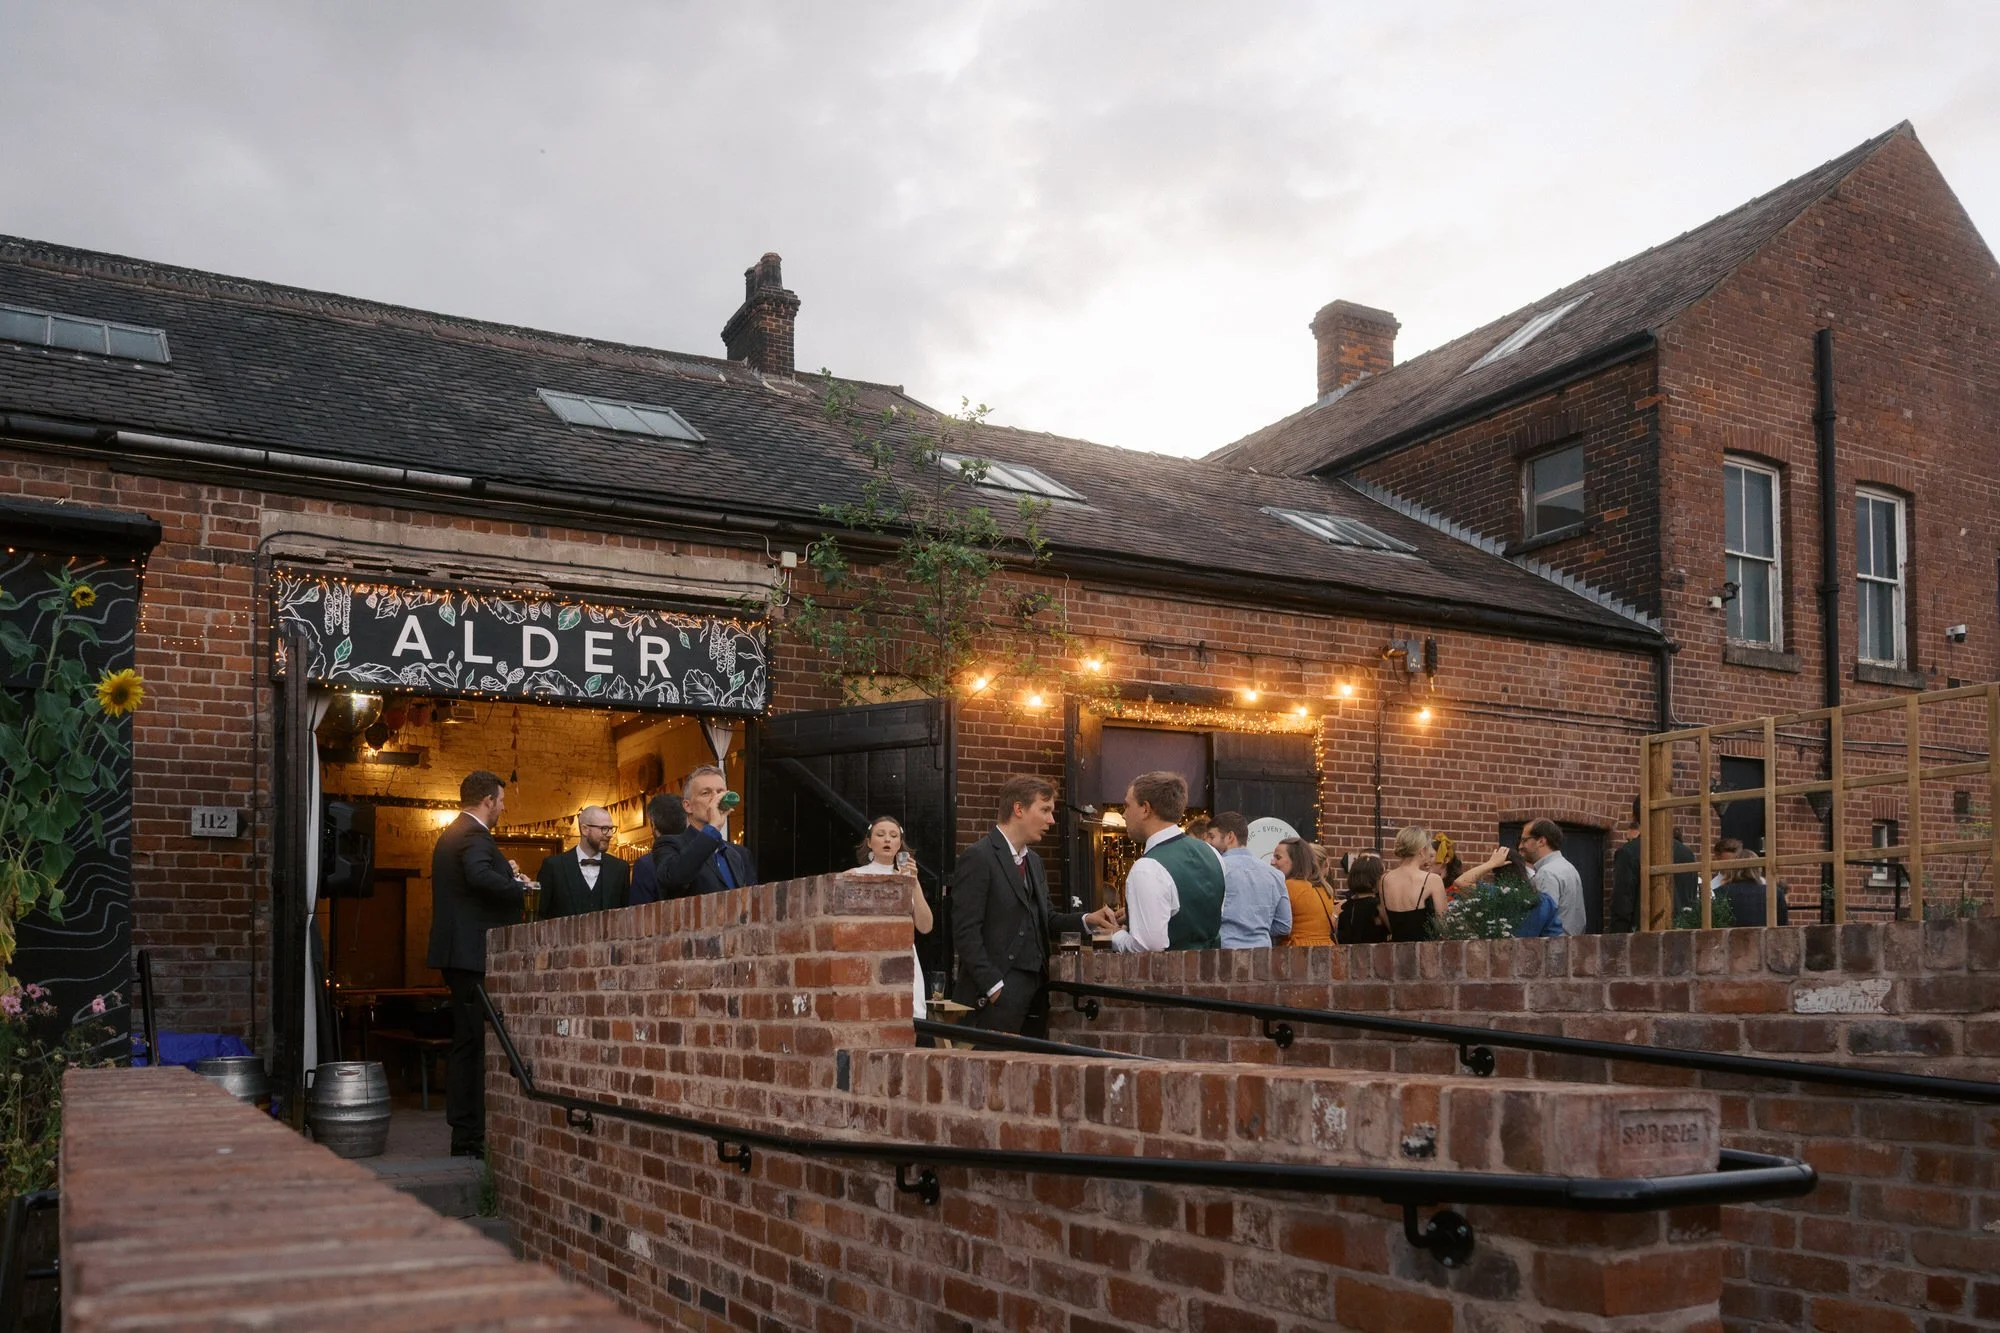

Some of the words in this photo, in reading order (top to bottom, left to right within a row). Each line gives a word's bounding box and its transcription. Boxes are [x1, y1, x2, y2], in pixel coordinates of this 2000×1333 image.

[392, 614, 672, 679] ALDER
[199, 812, 228, 829] 112
[1262, 825, 1283, 833] EVENT
